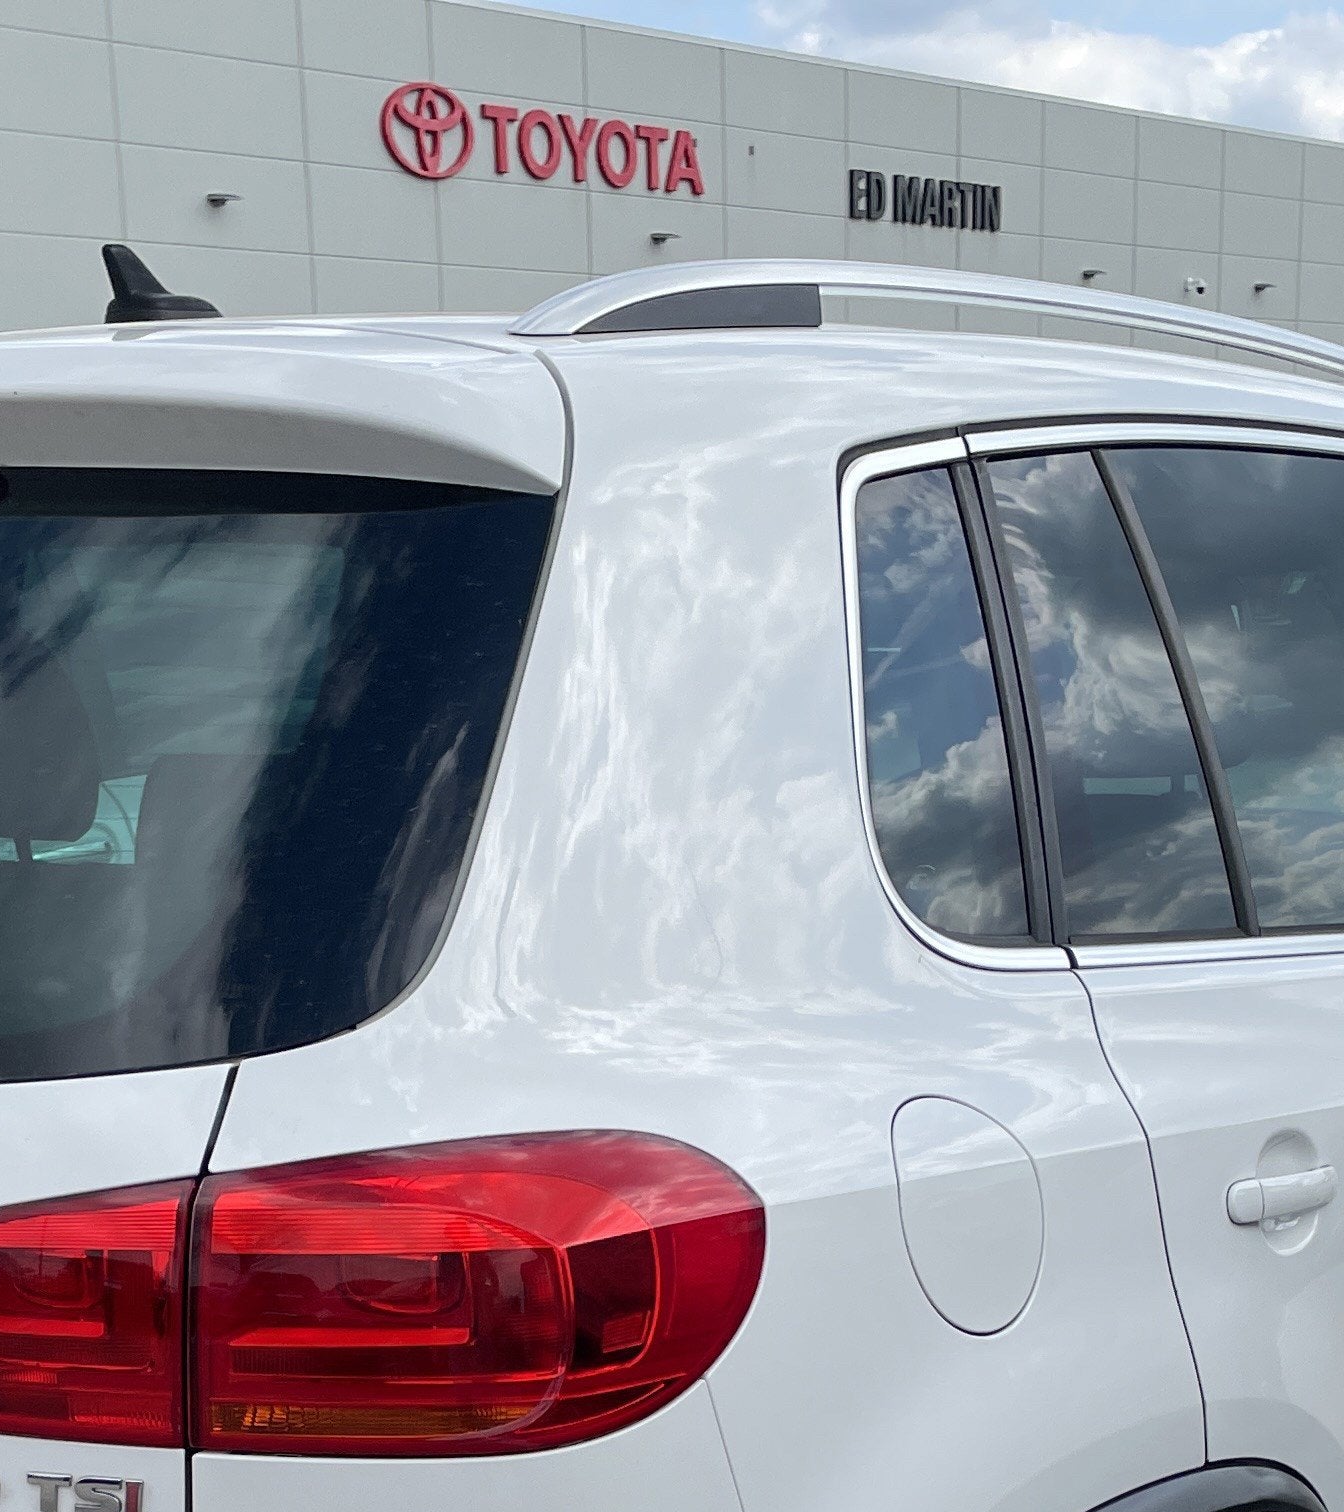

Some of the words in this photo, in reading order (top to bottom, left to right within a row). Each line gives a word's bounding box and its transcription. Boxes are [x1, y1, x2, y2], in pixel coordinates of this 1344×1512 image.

[480, 103, 704, 195] TOYOTA
[849, 168, 886, 221] ED
[890, 174, 1003, 233] MARTIN
